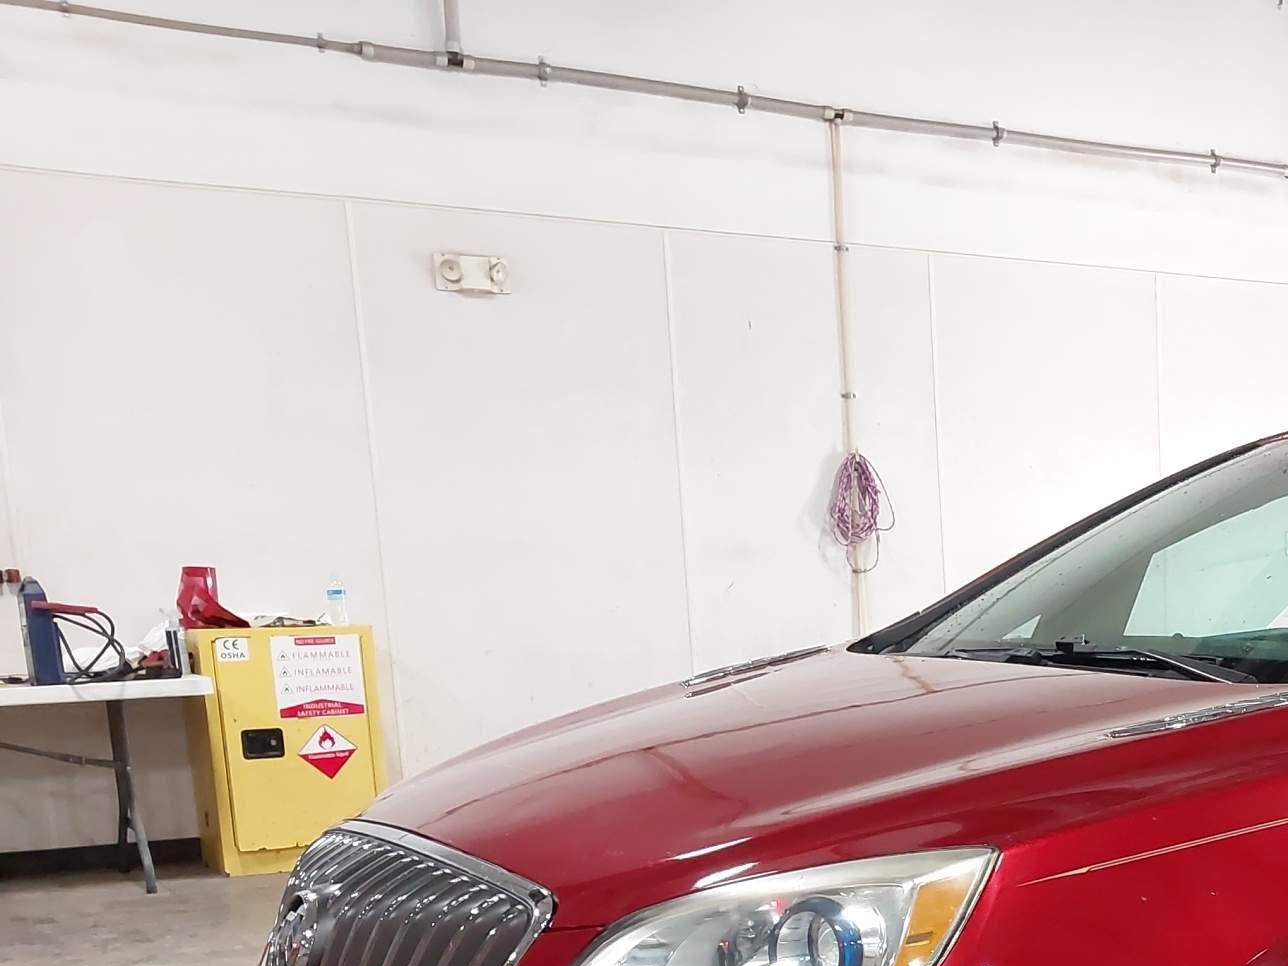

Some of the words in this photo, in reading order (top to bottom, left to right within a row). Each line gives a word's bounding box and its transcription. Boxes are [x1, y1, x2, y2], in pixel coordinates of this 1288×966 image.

[223, 639, 239, 650] CE
[292, 650, 351, 659] FLAMMABLE
[294, 666, 352, 676] INFLAMABLE
[295, 682, 353, 692] INFLAMMABLE
